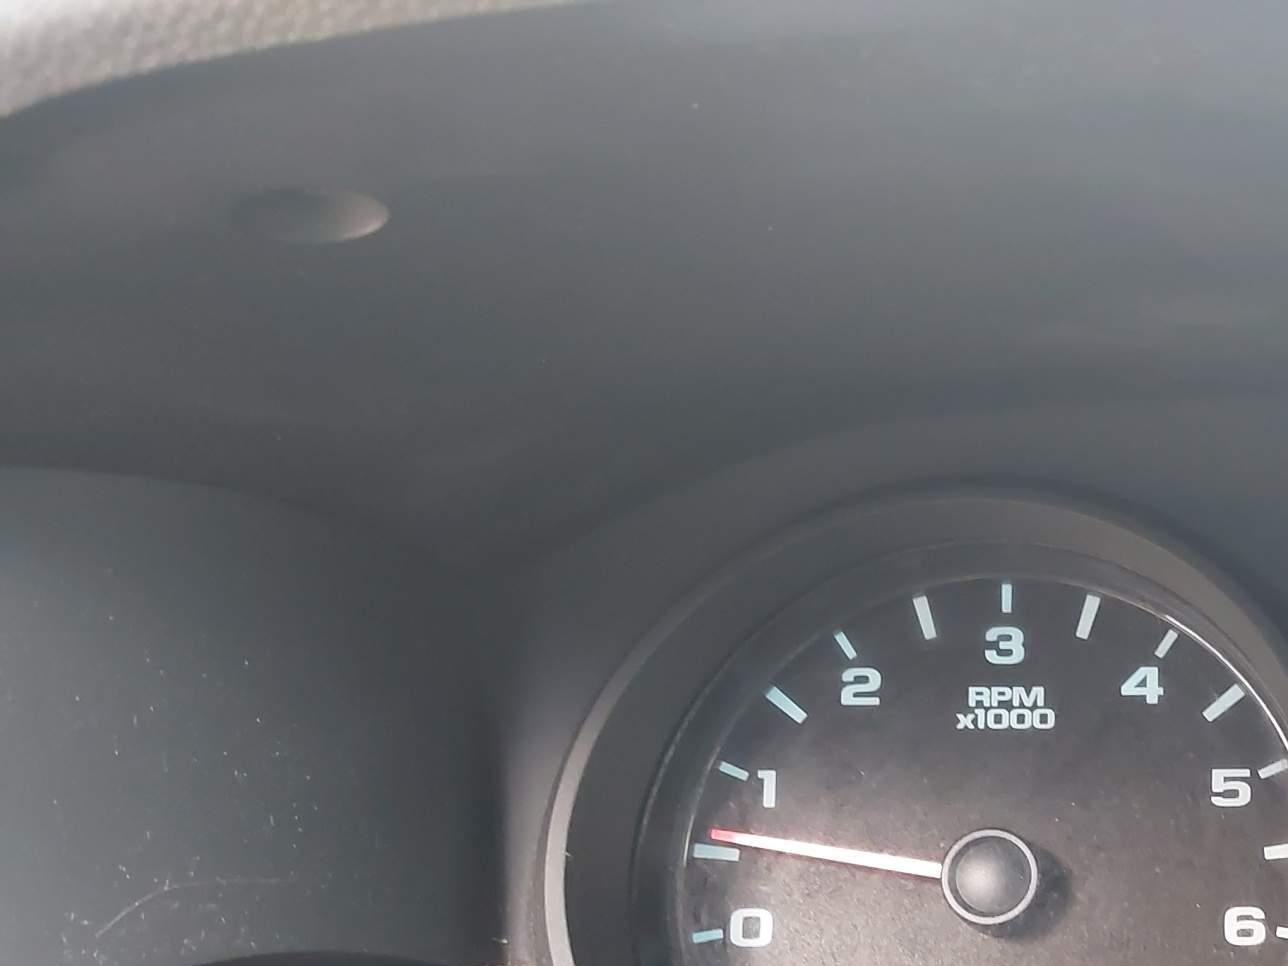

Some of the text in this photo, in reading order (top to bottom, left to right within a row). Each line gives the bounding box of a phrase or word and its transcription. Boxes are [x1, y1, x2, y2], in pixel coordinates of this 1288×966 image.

[984, 627, 1026, 665] 3
[840, 667, 881, 706] 2
[968, 686, 1045, 707] RPM
[1120, 666, 1164, 704] 4
[956, 708, 1055, 730] x1000
[757, 770, 777, 807] 1
[1211, 769, 1251, 807] 5
[730, 909, 773, 947] 0
[1224, 907, 1266, 946] 6
